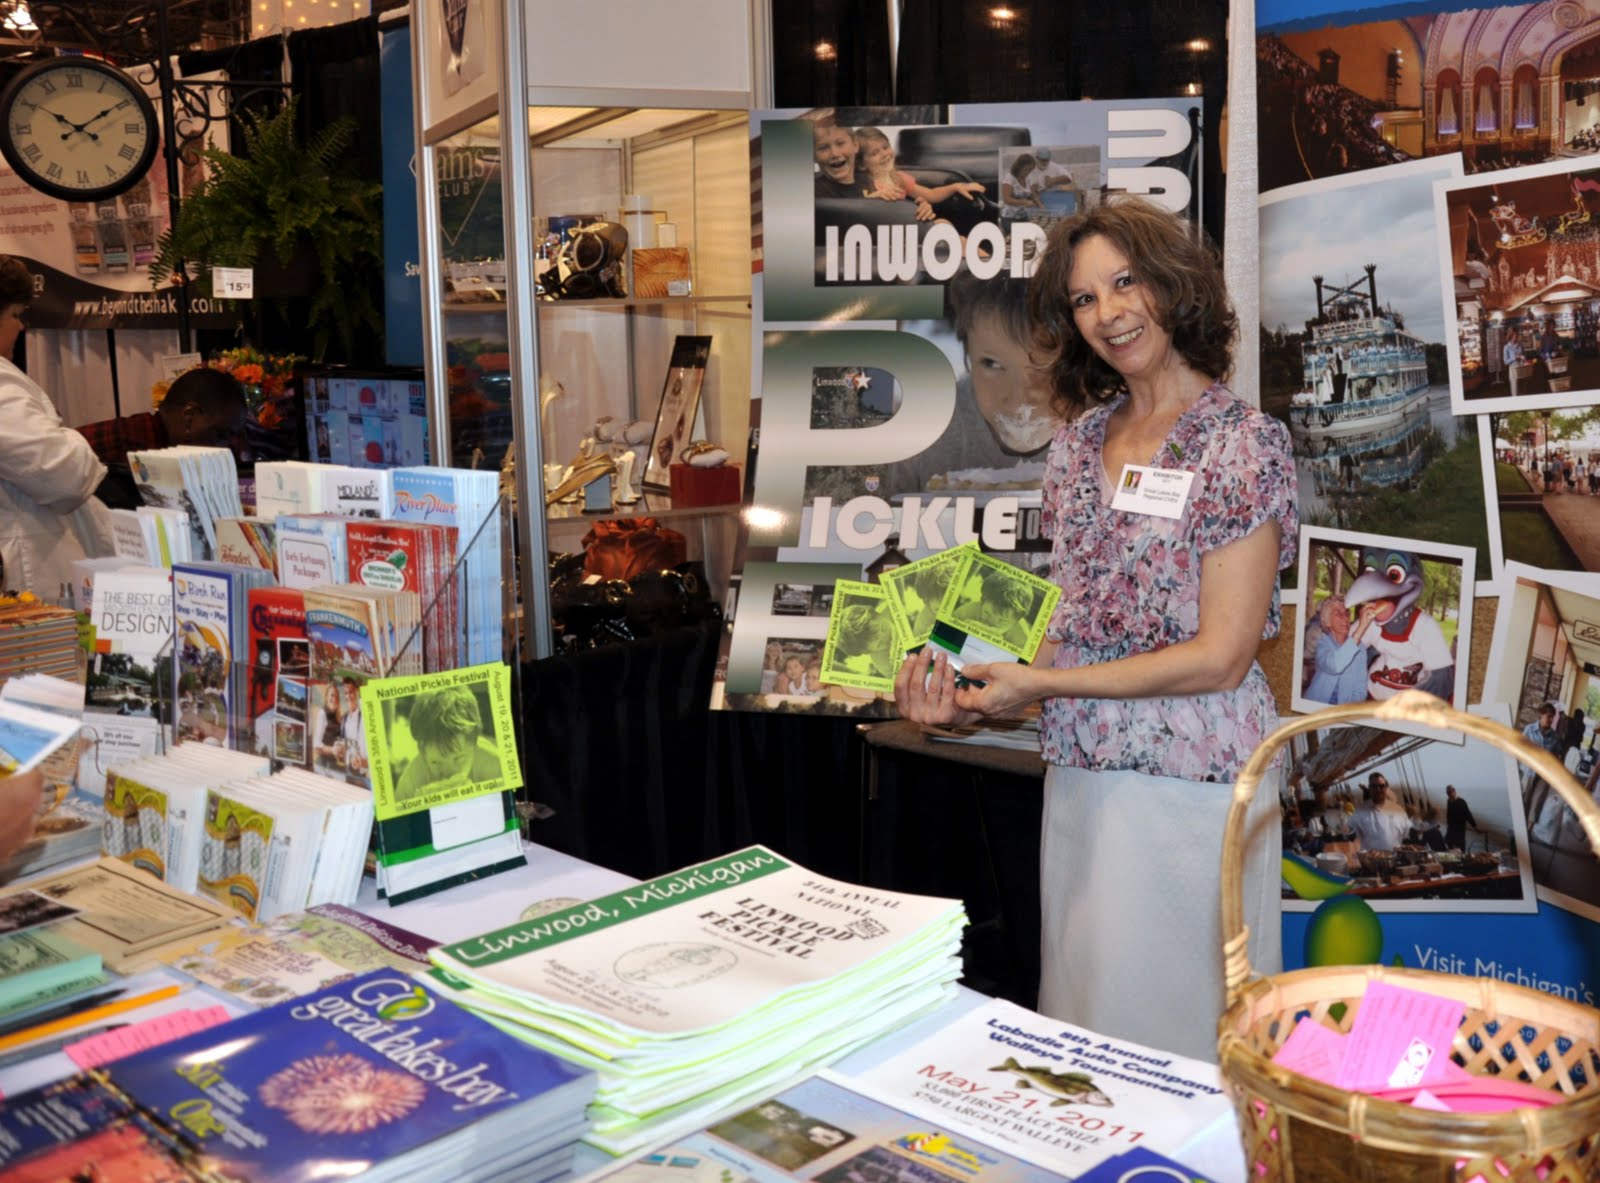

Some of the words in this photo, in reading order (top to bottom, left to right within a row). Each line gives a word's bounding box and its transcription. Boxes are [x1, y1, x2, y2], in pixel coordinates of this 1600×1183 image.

[74, 293, 224, 318] www.beyondtheshak.com
[890, 563, 918, 578] National
[973, 553, 1000, 571] National
[1001, 564, 1024, 578] Pickle
[1024, 573, 1051, 591] Festival
[104, 591, 125, 605] THE
[127, 592, 153, 606] BEST
[833, 590, 844, 618] Festival
[102, 612, 171, 635] DESIGN
[829, 617, 839, 641] Pickle
[967, 624, 980, 635] kids
[981, 630, 992, 639] will
[992, 635, 1002, 644] eat
[824, 642, 835, 672] National
[376, 684, 419, 699] National
[421, 677, 451, 690] Pickle
[453, 669, 490, 684] Festival
[365, 700, 377, 734] Annual
[494, 670, 504, 702] August
[501, 720, 510, 732] 20
[507, 759, 517, 780] 2011
[375, 759, 388, 807] Linwood's
[401, 799, 422, 810] Your
[424, 794, 442, 804] kids
[444, 789, 459, 799] will
[460, 785, 475, 796] eat
[476, 783, 481, 793] it
[456, 903, 620, 960] Linwood,
[623, 855, 774, 909] Michigan
[793, 891, 871, 916] NATIONAL
[842, 891, 901, 909] ANNUAL
[698, 910, 816, 960] FESTIVAL
[729, 909, 824, 947] PICKLE
[736, 897, 855, 942] LINWOOD
[1414, 944, 1466, 976] Visit
[1475, 957, 1595, 1006] Michigan's
[987, 1018, 1065, 1049] Labadie
[1066, 1046, 1118, 1067] Auto
[1122, 1061, 1224, 1095] Company
[988, 1031, 1065, 1062] Walleye
[1069, 1057, 1197, 1100] Tournament
[1058, 1031, 1092, 1047] 8th
[1094, 1041, 1174, 1068] Annual
[436, 1063, 519, 1111] bay
[917, 1064, 991, 1094] May
[992, 1090, 1041, 1115] 21,
[1056, 1110, 1145, 1144] 2011
[942, 1101, 1010, 1131] LARGEST
[1011, 1122, 1087, 1154] WALLEYE
[960, 1094, 1005, 1113] FIRST
[1003, 1105, 1054, 1131] PLACE
[1055, 1125, 1106, 1146] PRIZE
